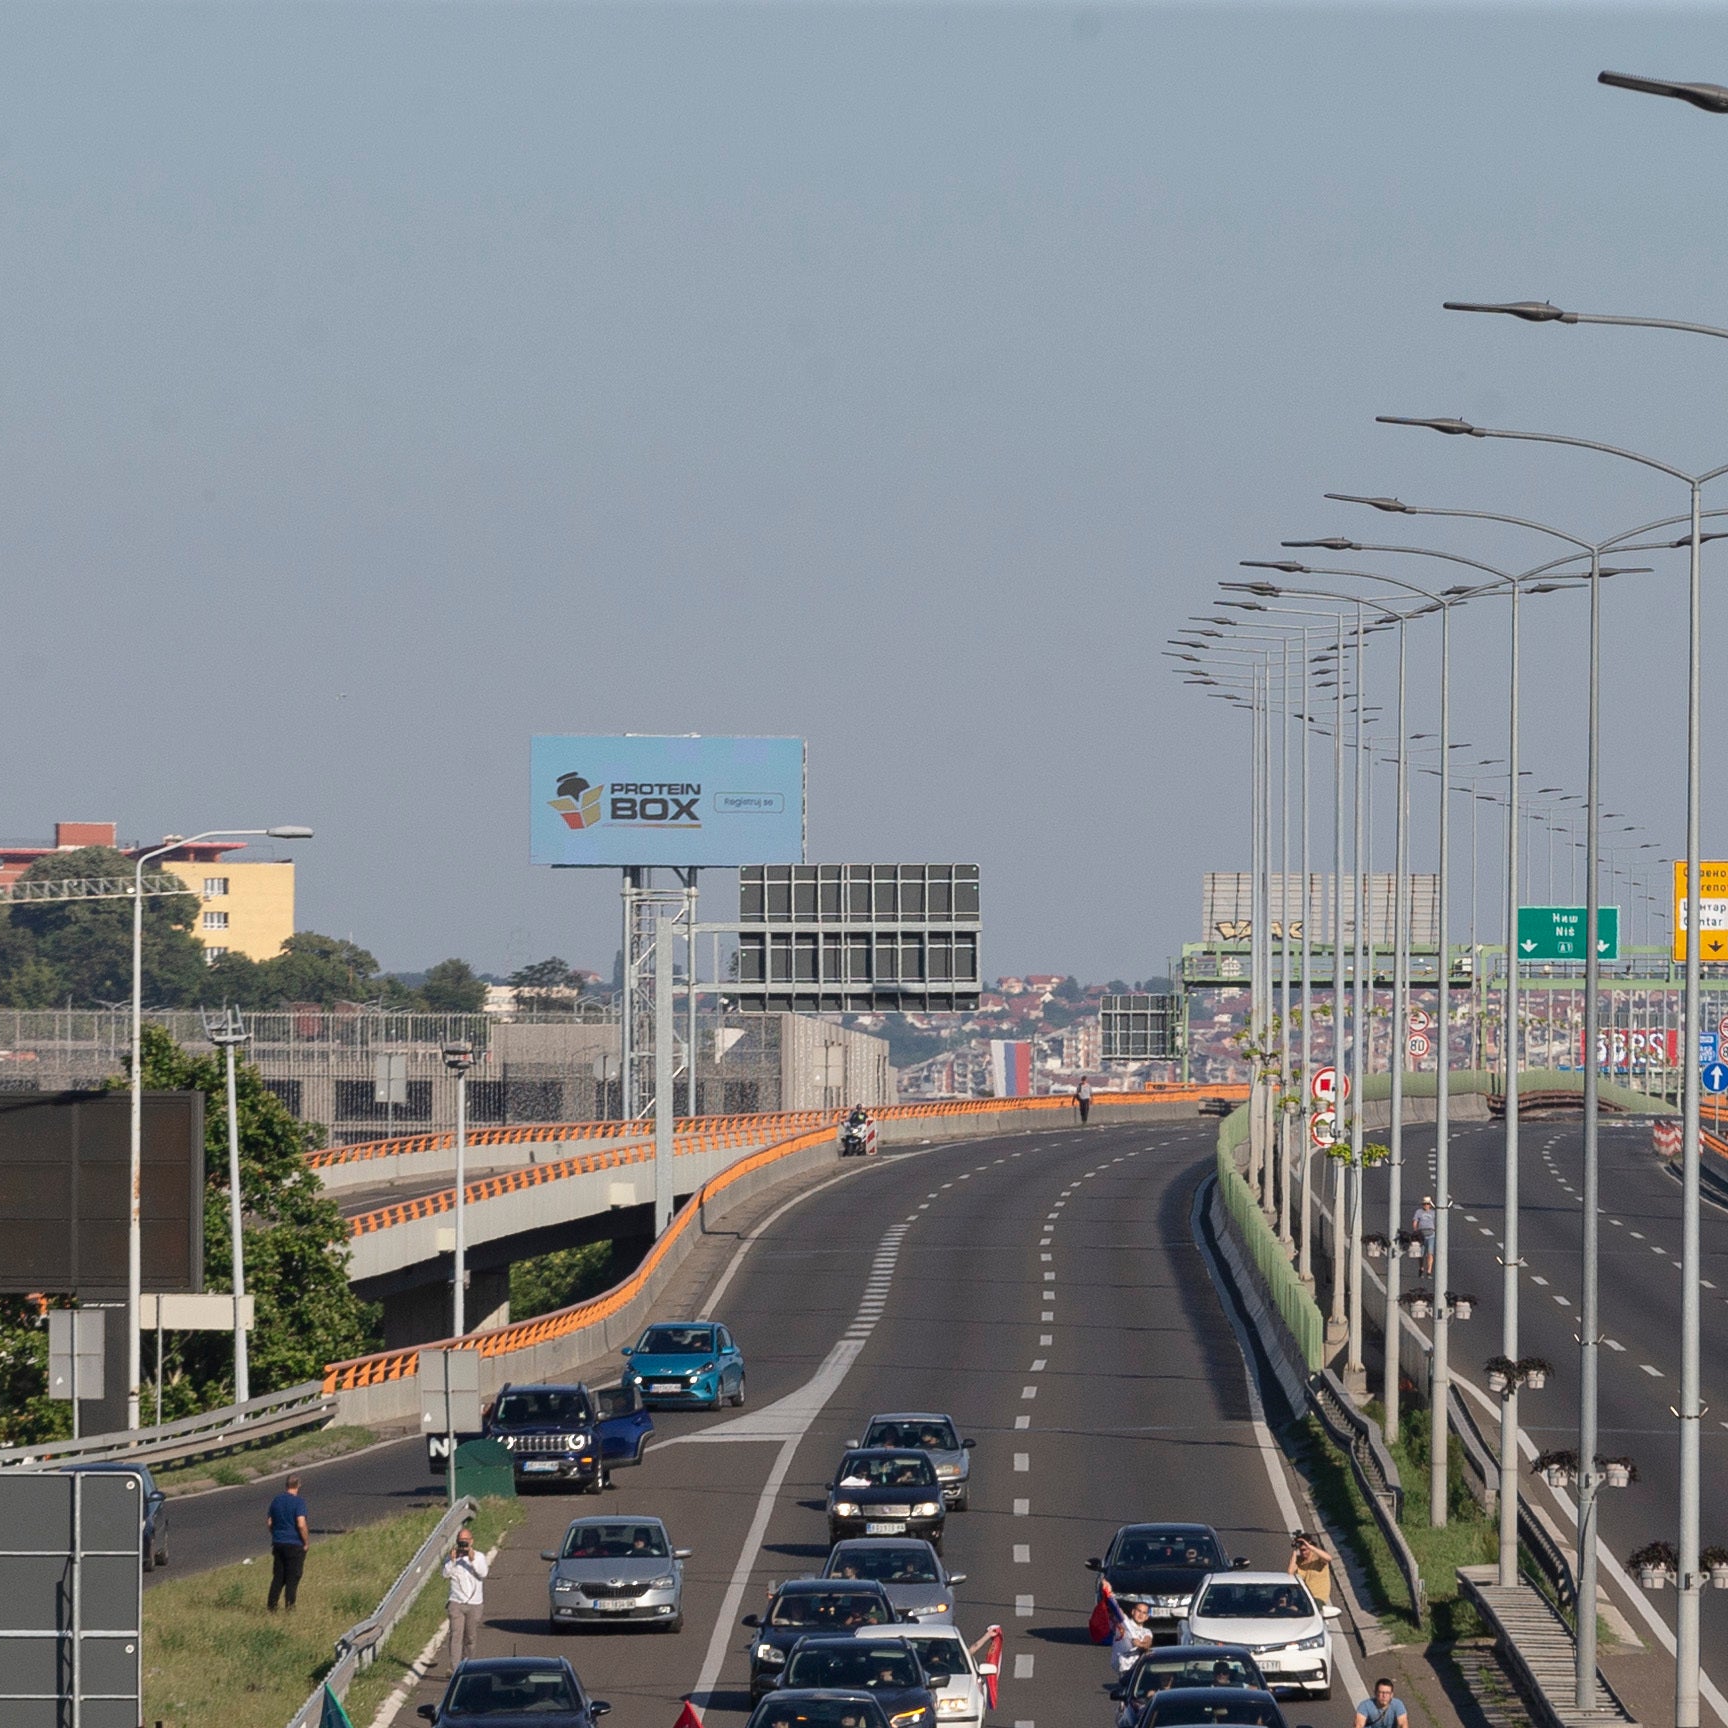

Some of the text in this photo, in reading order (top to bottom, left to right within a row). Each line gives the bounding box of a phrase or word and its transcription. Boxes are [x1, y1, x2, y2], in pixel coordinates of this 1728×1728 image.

[610, 783, 702, 796] PROTEIN
[610, 798, 700, 821] BOX
[1552, 912, 1579, 924] Ниш
[1555, 926, 1575, 937] Niš
[1410, 1040, 1424, 1052] 80
